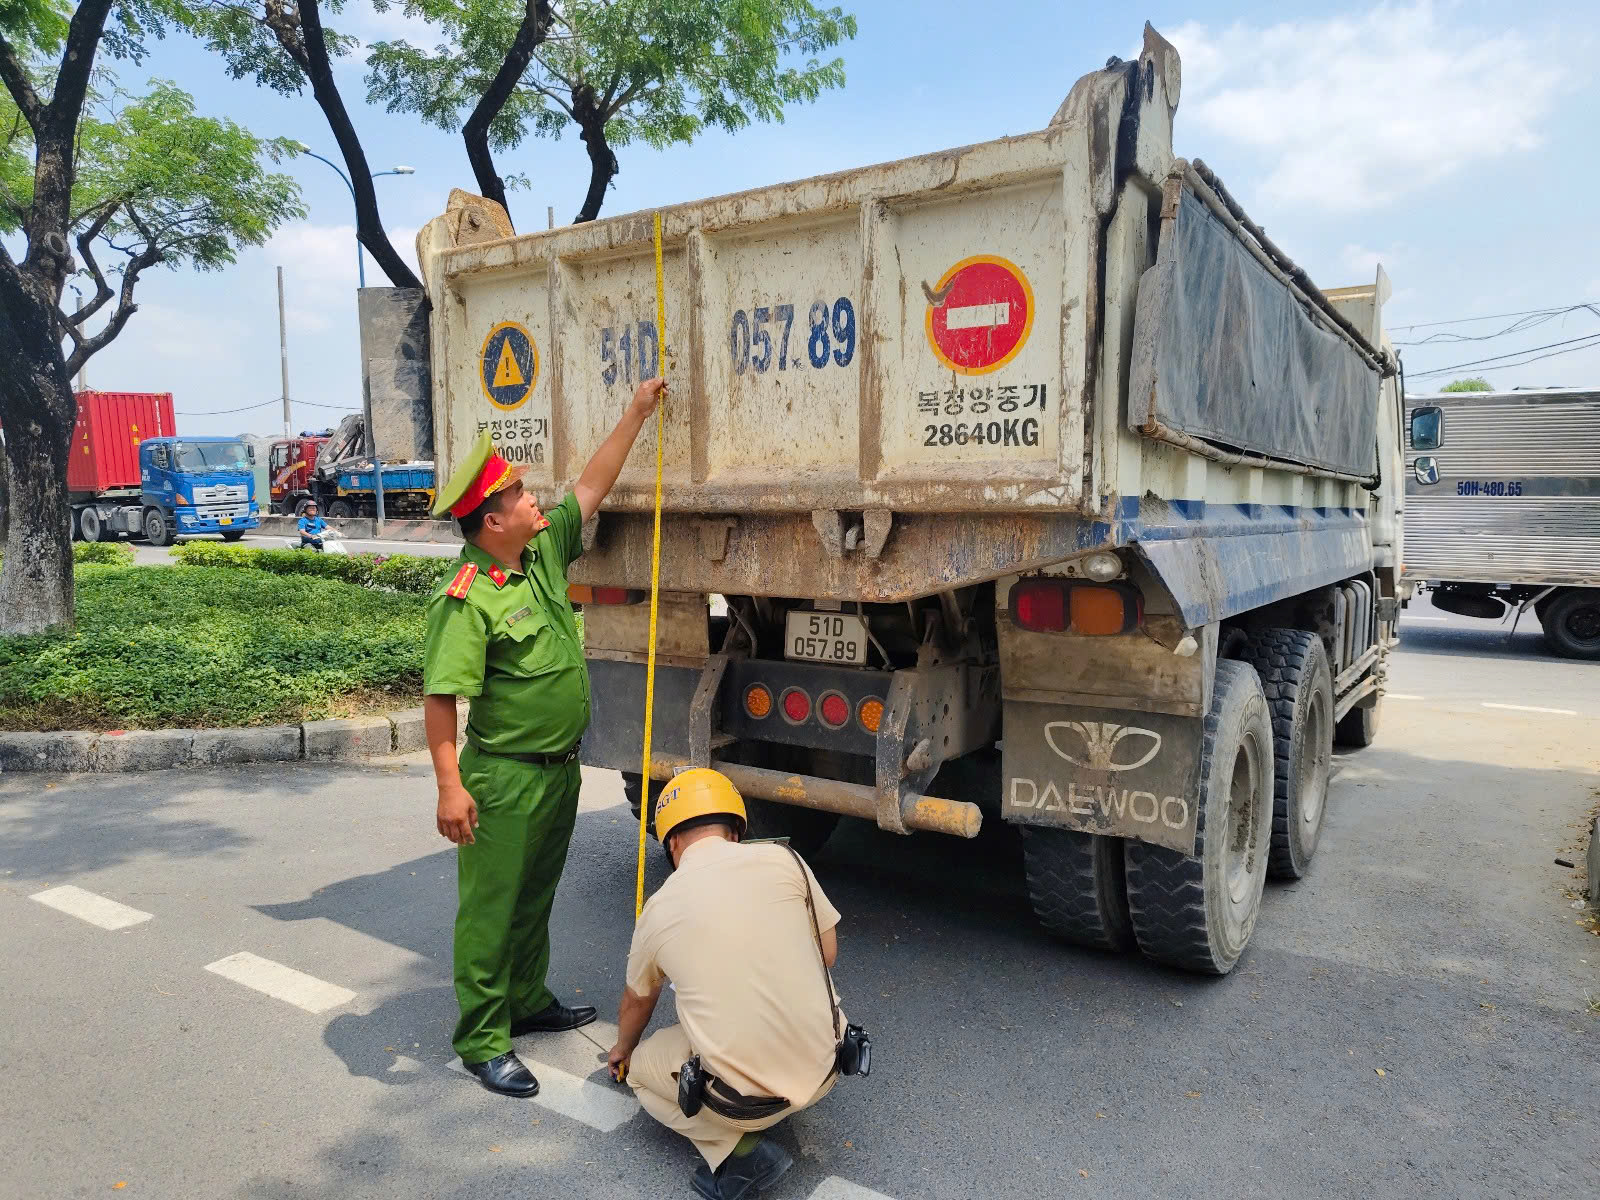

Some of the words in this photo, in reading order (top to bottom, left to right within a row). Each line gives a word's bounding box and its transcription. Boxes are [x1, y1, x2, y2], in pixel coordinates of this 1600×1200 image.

[730, 296, 856, 376] 057.89
[923, 417, 1039, 447] 28640KG
[1456, 481, 1523, 497] 50H-480.65
[809, 616, 844, 637] 51D
[794, 636, 857, 661] 057.89
[1010, 777, 1189, 830] DAEWOO
